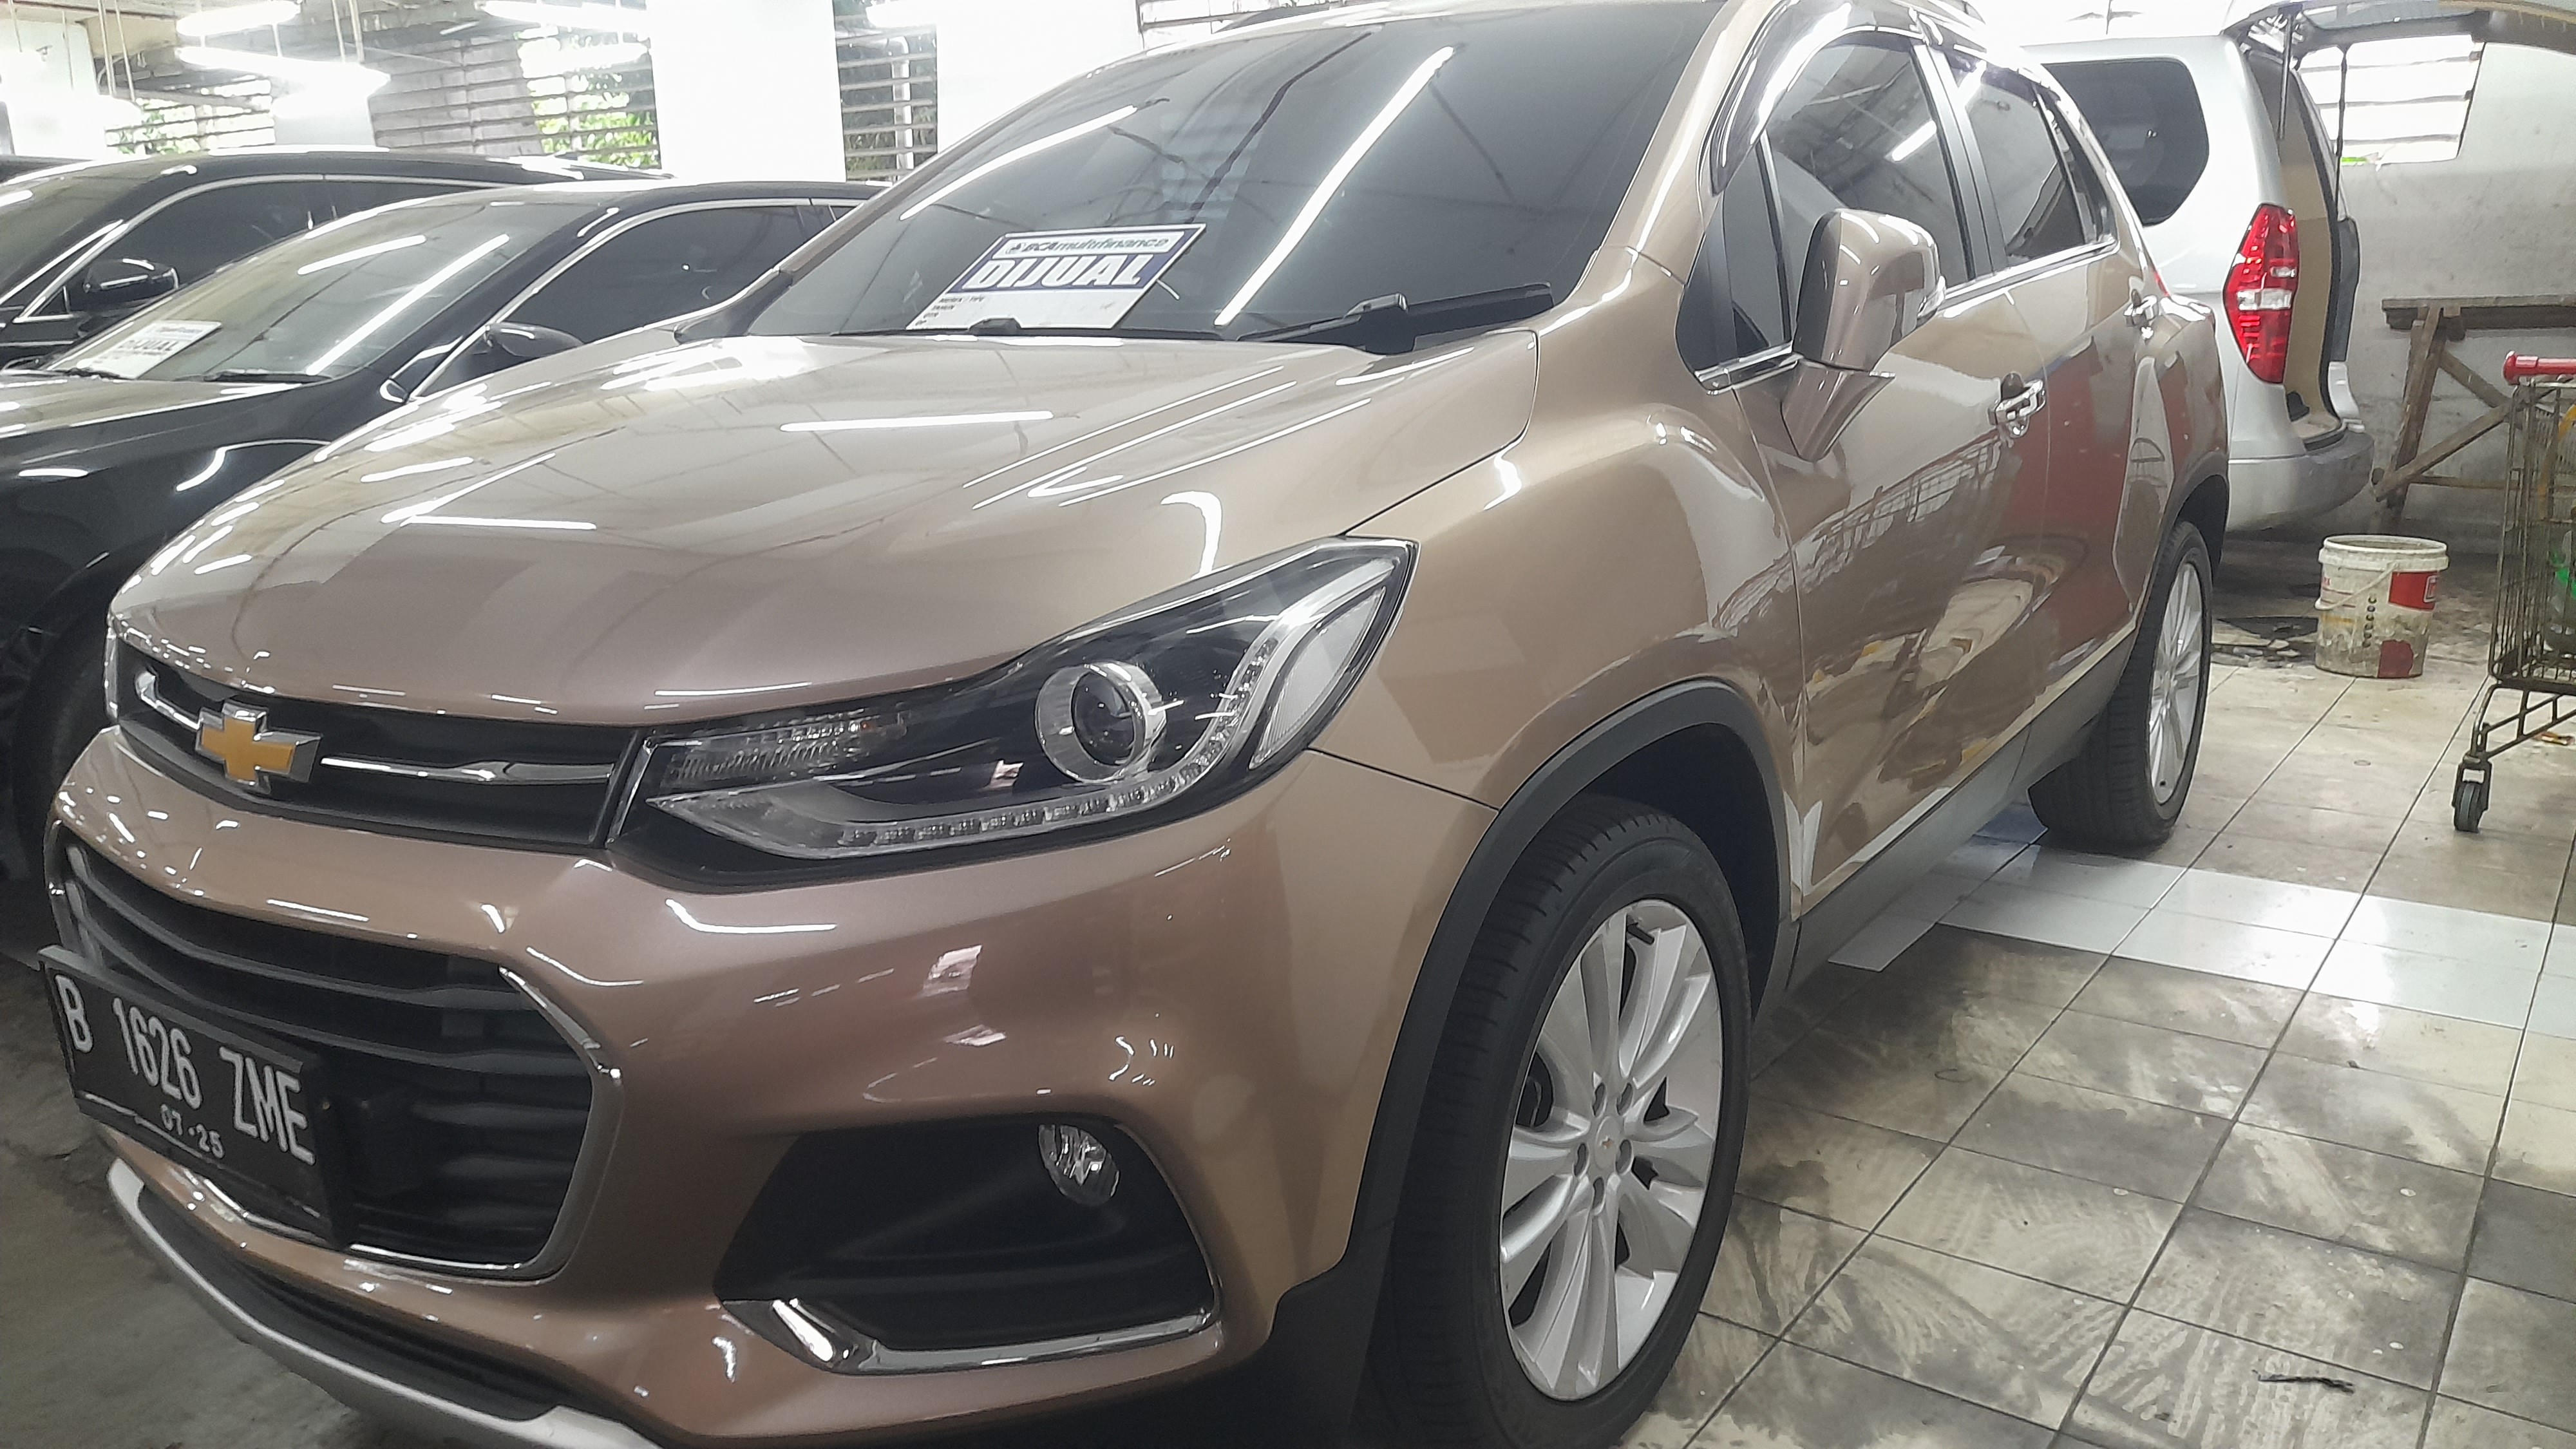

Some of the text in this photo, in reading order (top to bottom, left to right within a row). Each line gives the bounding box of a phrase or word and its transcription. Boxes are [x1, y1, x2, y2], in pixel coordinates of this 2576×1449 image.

[961, 254, 1154, 290] DIJUAL
[55, 974, 316, 1167] B 1626 ZME
